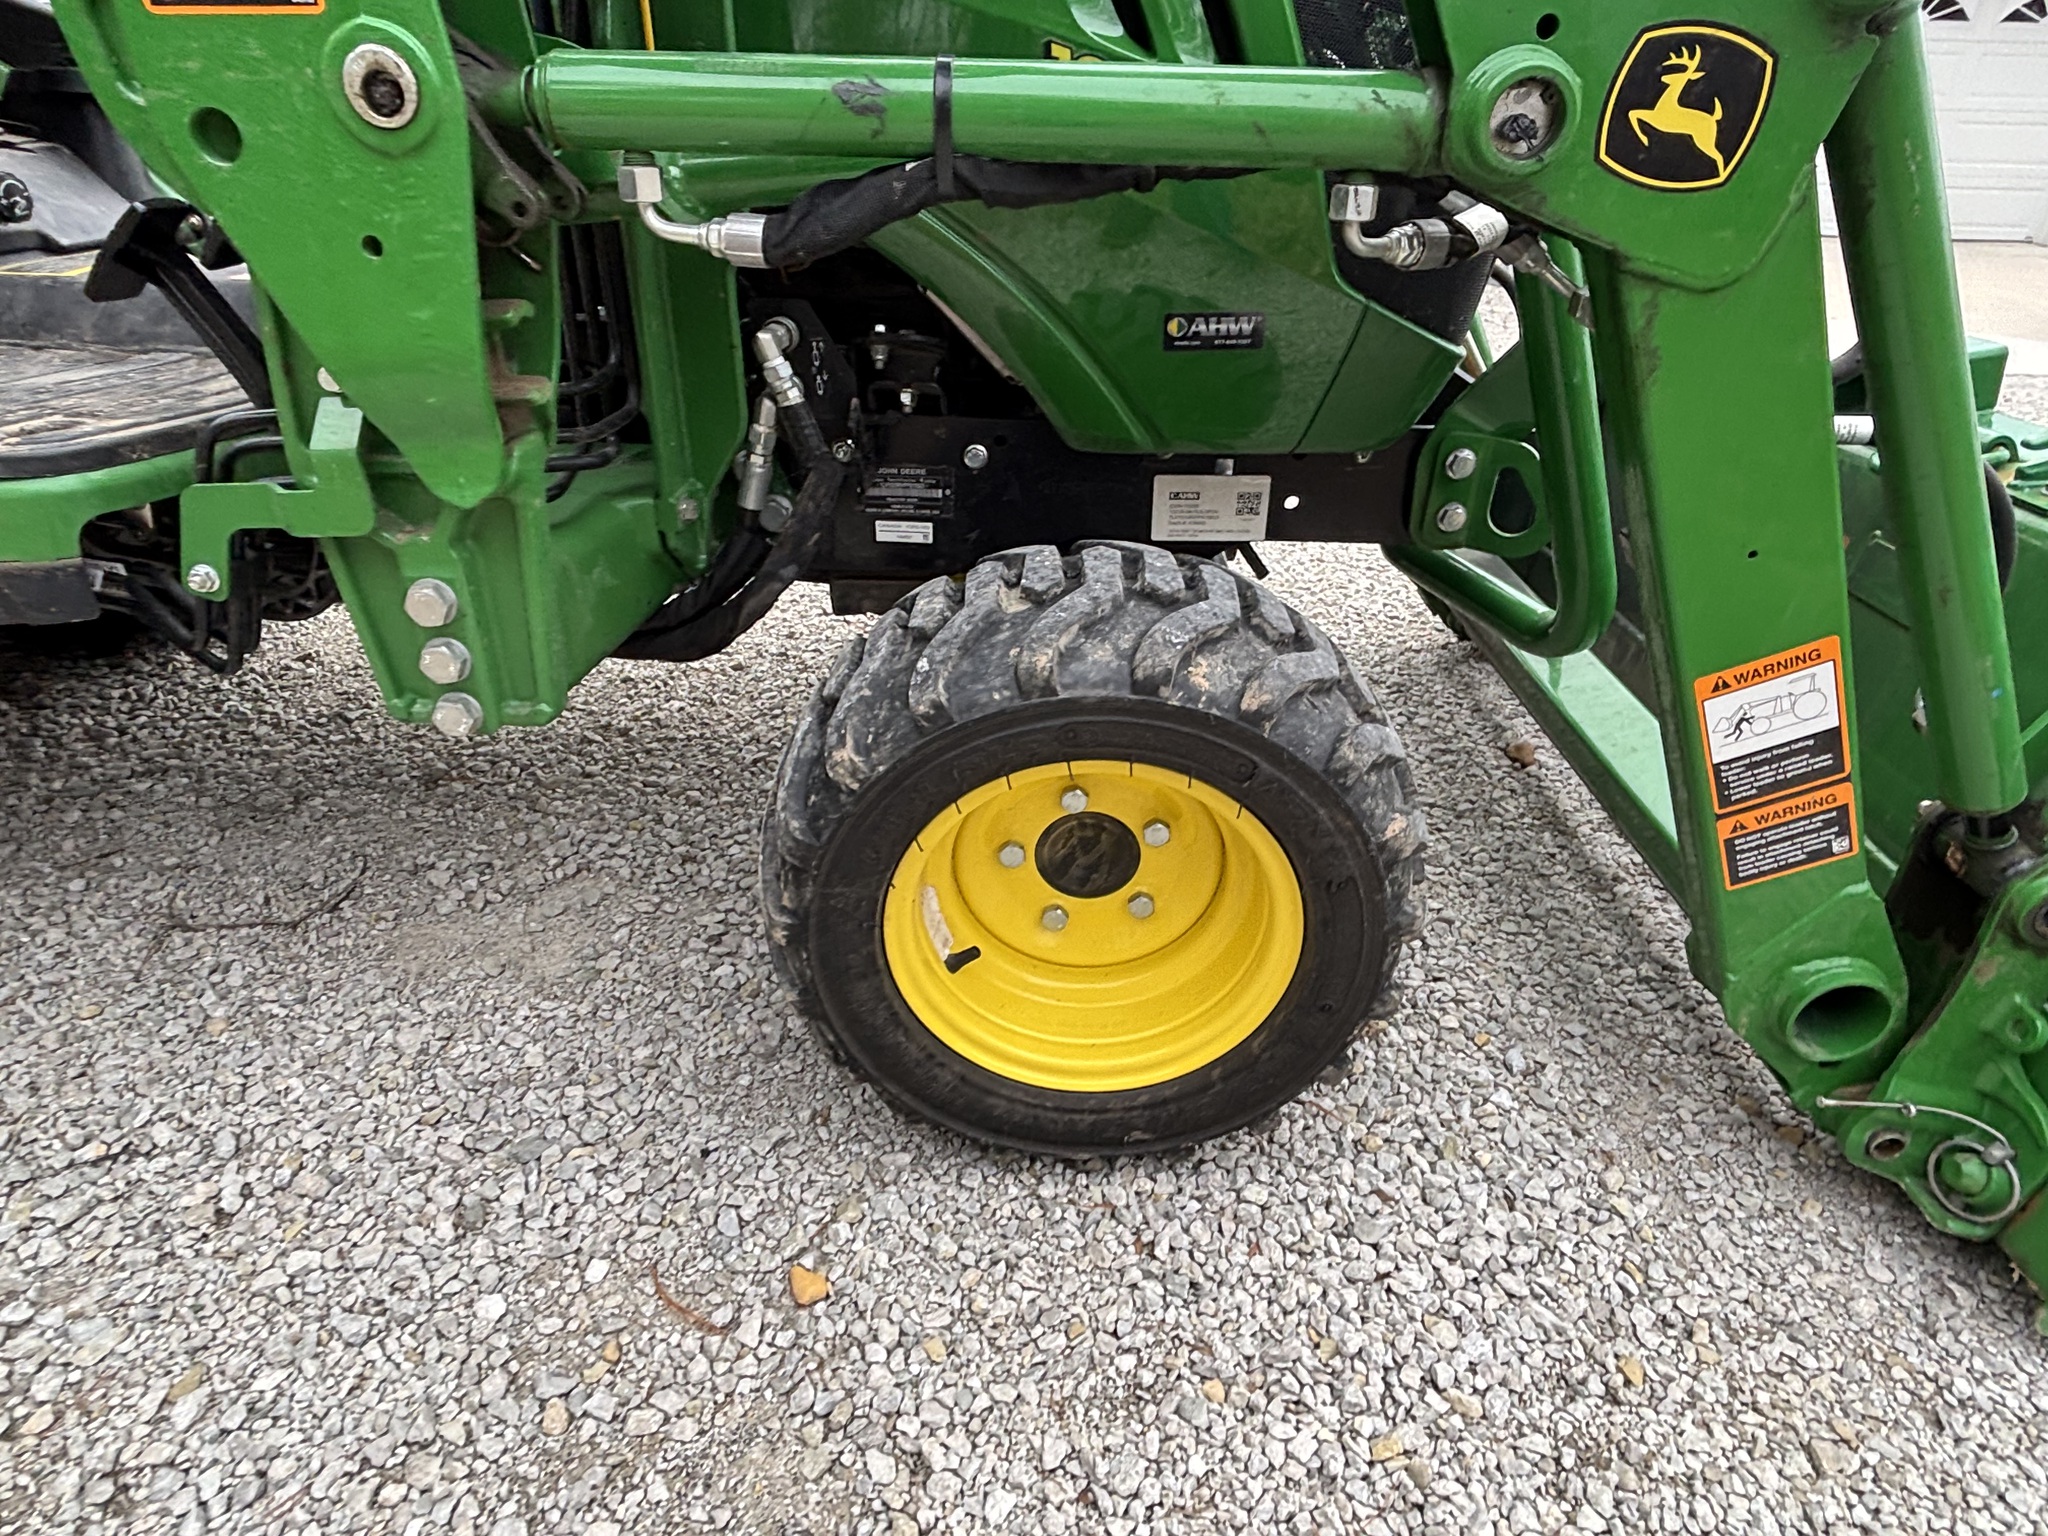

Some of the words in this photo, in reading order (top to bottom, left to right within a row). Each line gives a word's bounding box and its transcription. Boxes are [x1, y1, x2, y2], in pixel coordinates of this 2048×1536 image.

[1186, 316, 1257, 336] AHW
[877, 467, 898, 475] JOHN
[1733, 648, 1822, 685] WARNING
[1754, 793, 1837, 826] WARNING
